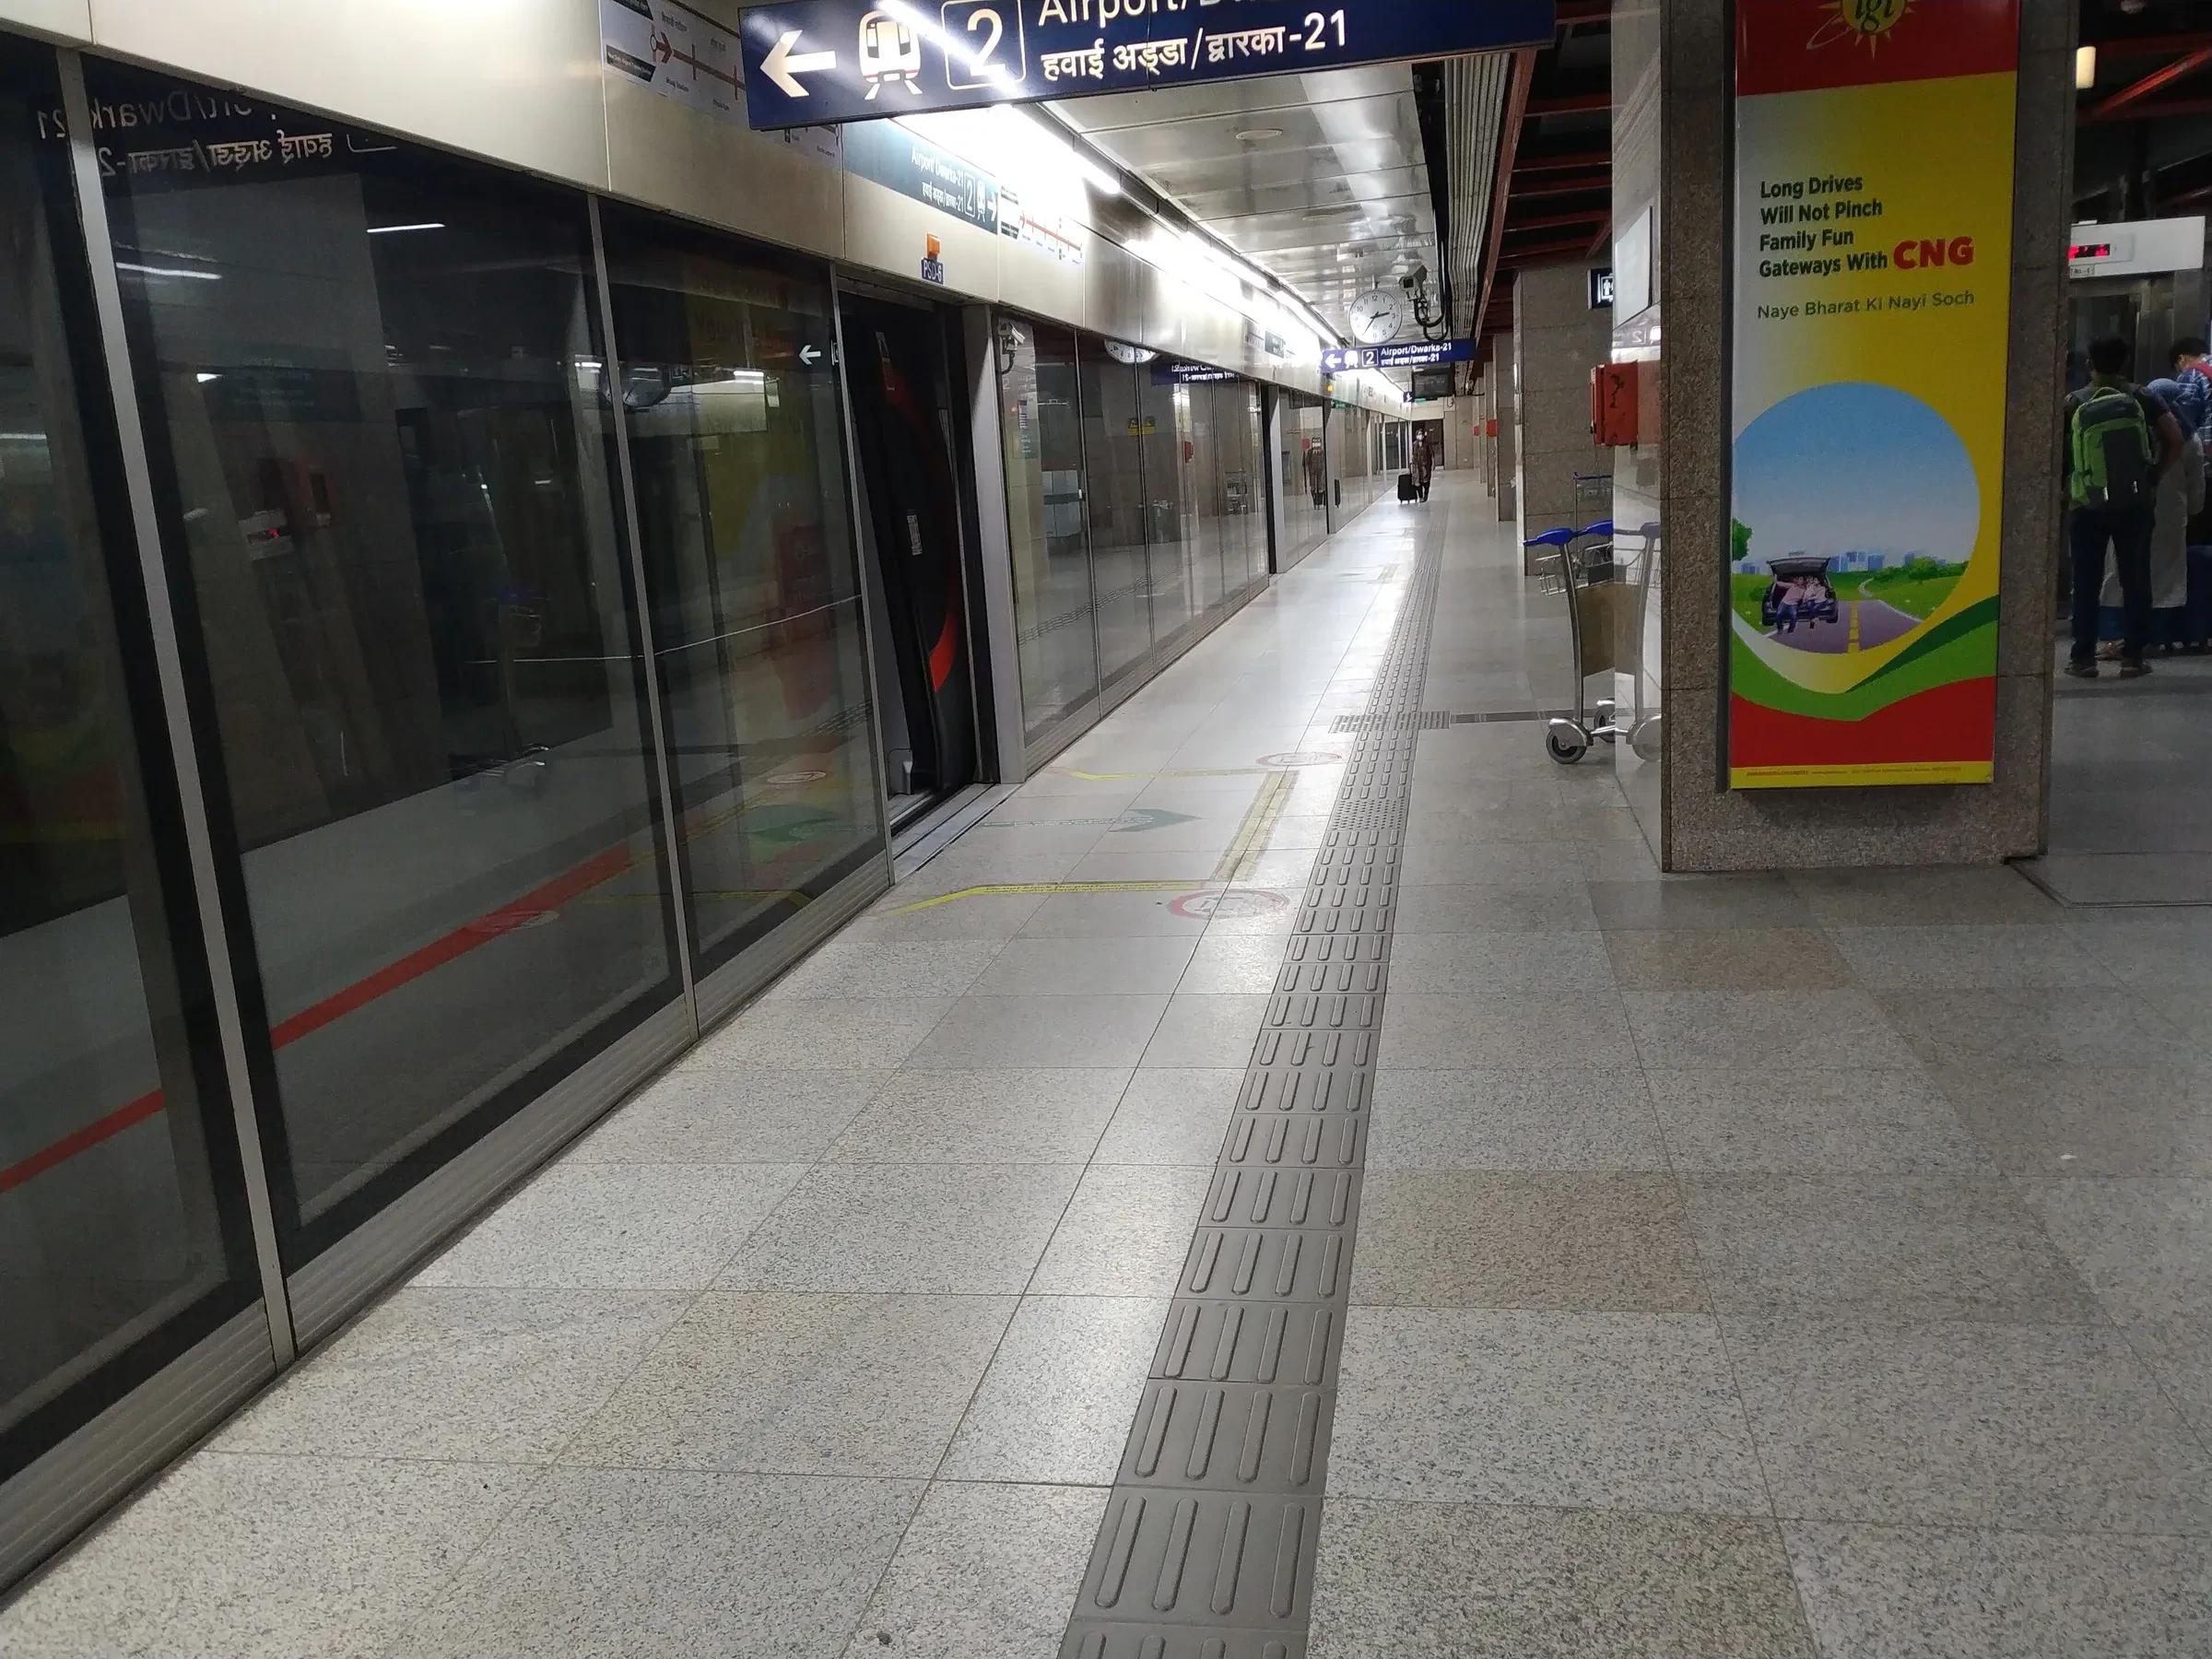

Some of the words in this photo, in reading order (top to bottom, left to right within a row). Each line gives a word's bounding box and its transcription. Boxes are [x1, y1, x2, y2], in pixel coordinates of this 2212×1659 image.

[965, 9, 1006, 77] 2
[1041, 39, 1104, 81] हवाई
[967, 180, 973, 212] 2
[1760, 181, 1804, 199] Long
[1808, 174, 1863, 194] Drives
[1760, 205, 1794, 226] Will
[1798, 203, 1830, 223] Not
[1835, 198, 1883, 219] Pinch
[1759, 230, 1817, 252] Family
[1822, 229, 1854, 247] Fun
[924, 260, 942, 282] PSD-6
[1759, 256, 1841, 278] Gateways
[1847, 251, 1888, 271] With
[1893, 236, 1974, 270] CNG
[1758, 304, 1799, 320] Naye
[1805, 298, 1860, 316] Bharat
[1888, 293, 1926, 311] Nayi
[1932, 288, 1974, 307] Soch
[1366, 351, 1374, 364] 2
[1381, 342, 1452, 358] Airport/Dwarka-21
